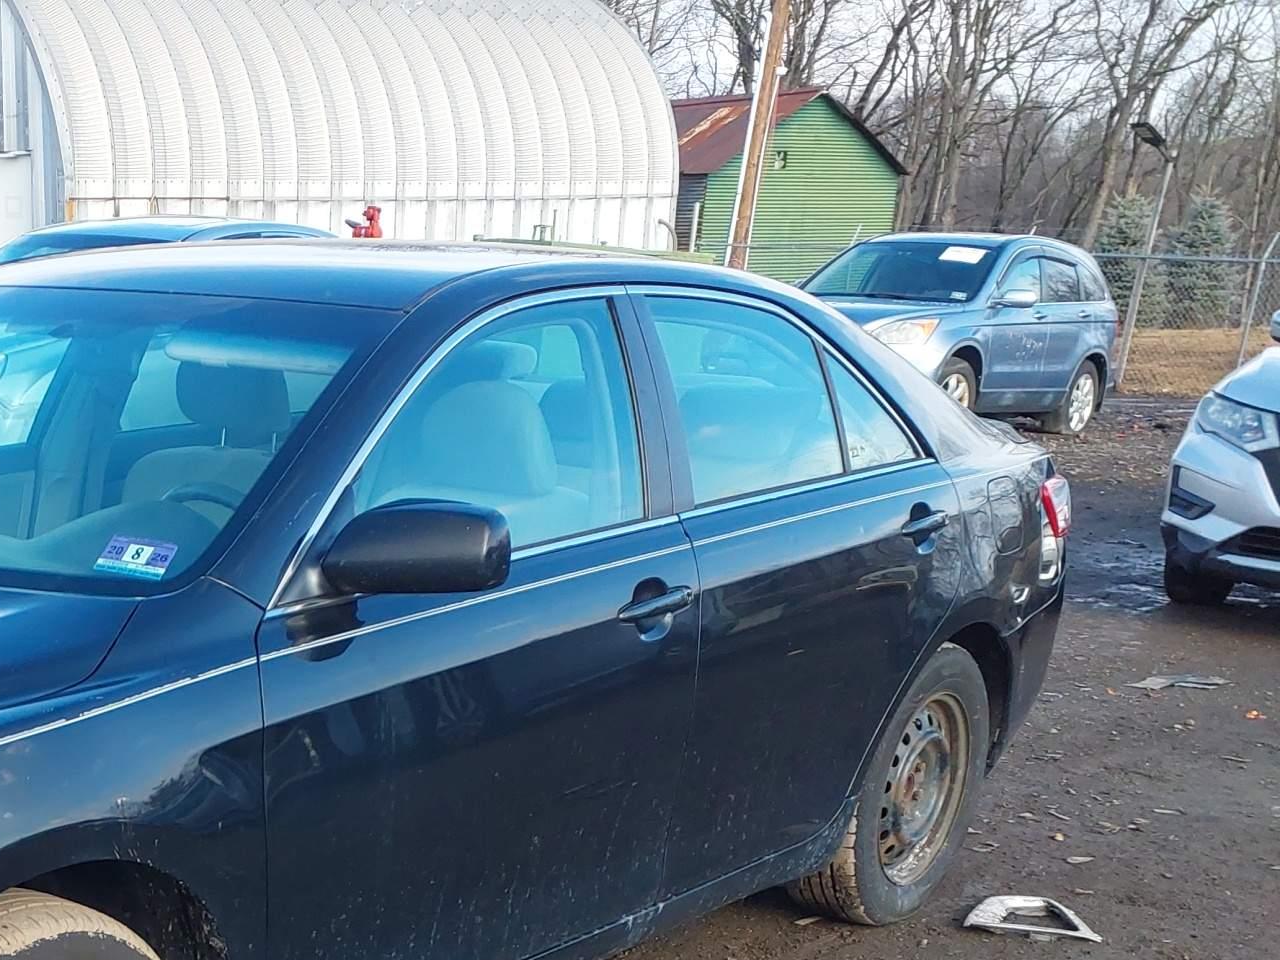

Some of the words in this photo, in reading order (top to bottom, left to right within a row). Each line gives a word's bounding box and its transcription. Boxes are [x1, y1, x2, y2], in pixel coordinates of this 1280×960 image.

[107, 545, 124, 556] 20
[131, 547, 145, 561] 8
[150, 552, 169, 563] 26
